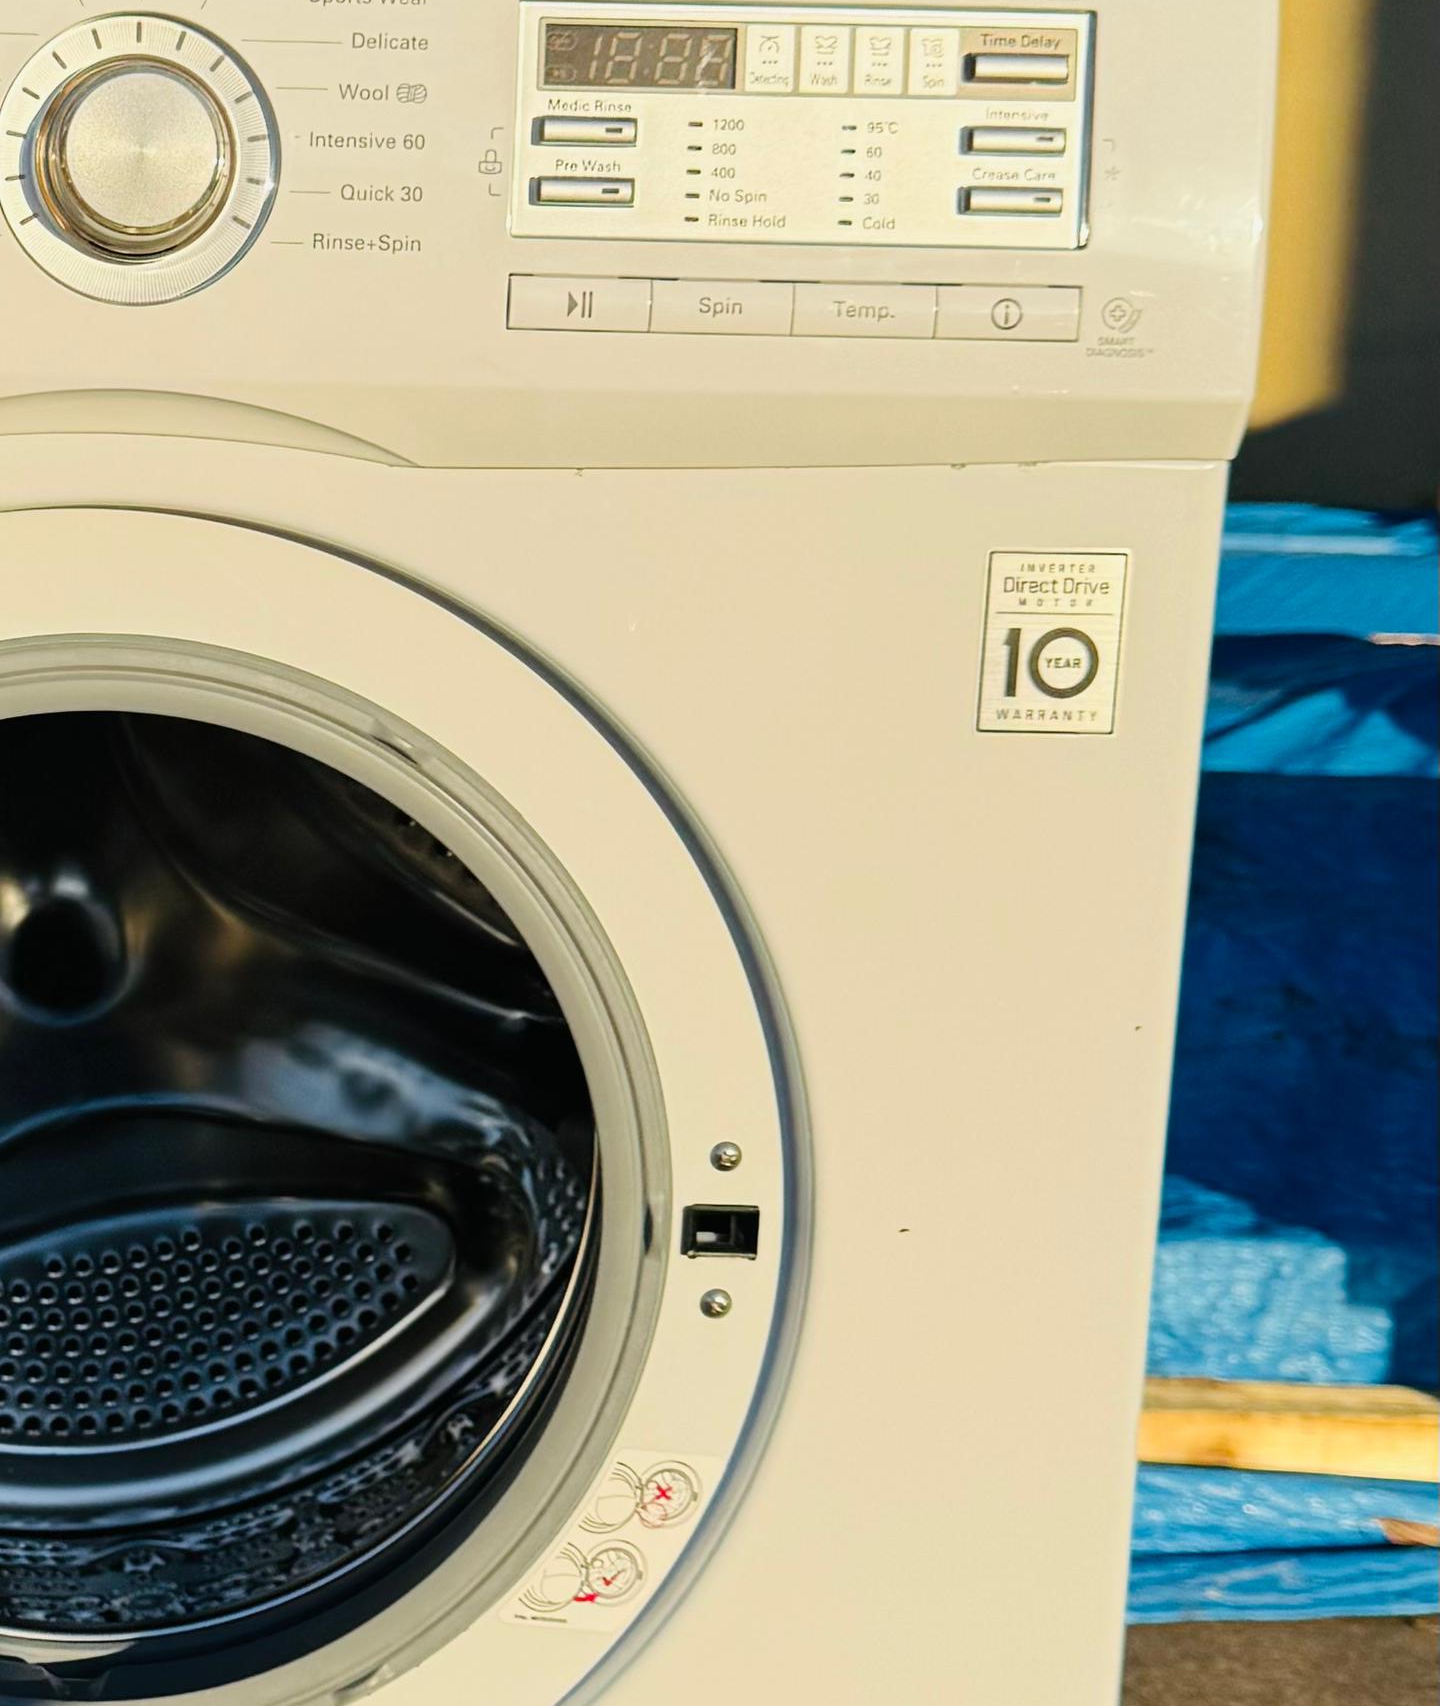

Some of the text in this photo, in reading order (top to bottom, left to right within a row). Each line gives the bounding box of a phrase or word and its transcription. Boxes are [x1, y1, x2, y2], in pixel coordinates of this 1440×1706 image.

[351, 32, 429, 50] Delicate
[980, 34, 1063, 50] Time Delay
[338, 83, 389, 101] Wool
[547, 99, 632, 113] Medic Rinse
[985, 107, 1049, 121] Intensive
[713, 118, 745, 131] 1200
[309, 131, 426, 150] Intensive 60
[712, 143, 737, 155] 800
[555, 159, 621, 173] Pre Wash
[711, 166, 736, 179] 400
[864, 170, 882, 182] 40
[972, 167, 1056, 182] Crease Care
[340, 184, 423, 202] Quick 30
[709, 189, 768, 205] No Spin
[863, 193, 880, 206] 30
[708, 213, 786, 228] Rinse Hold
[862, 217, 896, 231] Cold
[312, 233, 422, 254] Rinse+Spin
[698, 296, 743, 317] Spin
[832, 299, 896, 321] Temp.
[1020, 562, 1097, 574] INVERTER
[1003, 576, 1110, 595] Direct Drive
[1018, 598, 1094, 607] MOTOR
[1002, 626, 1100, 699] 10
[1044, 657, 1082, 669] YEAR
[995, 708, 1098, 721] WARRANTY
